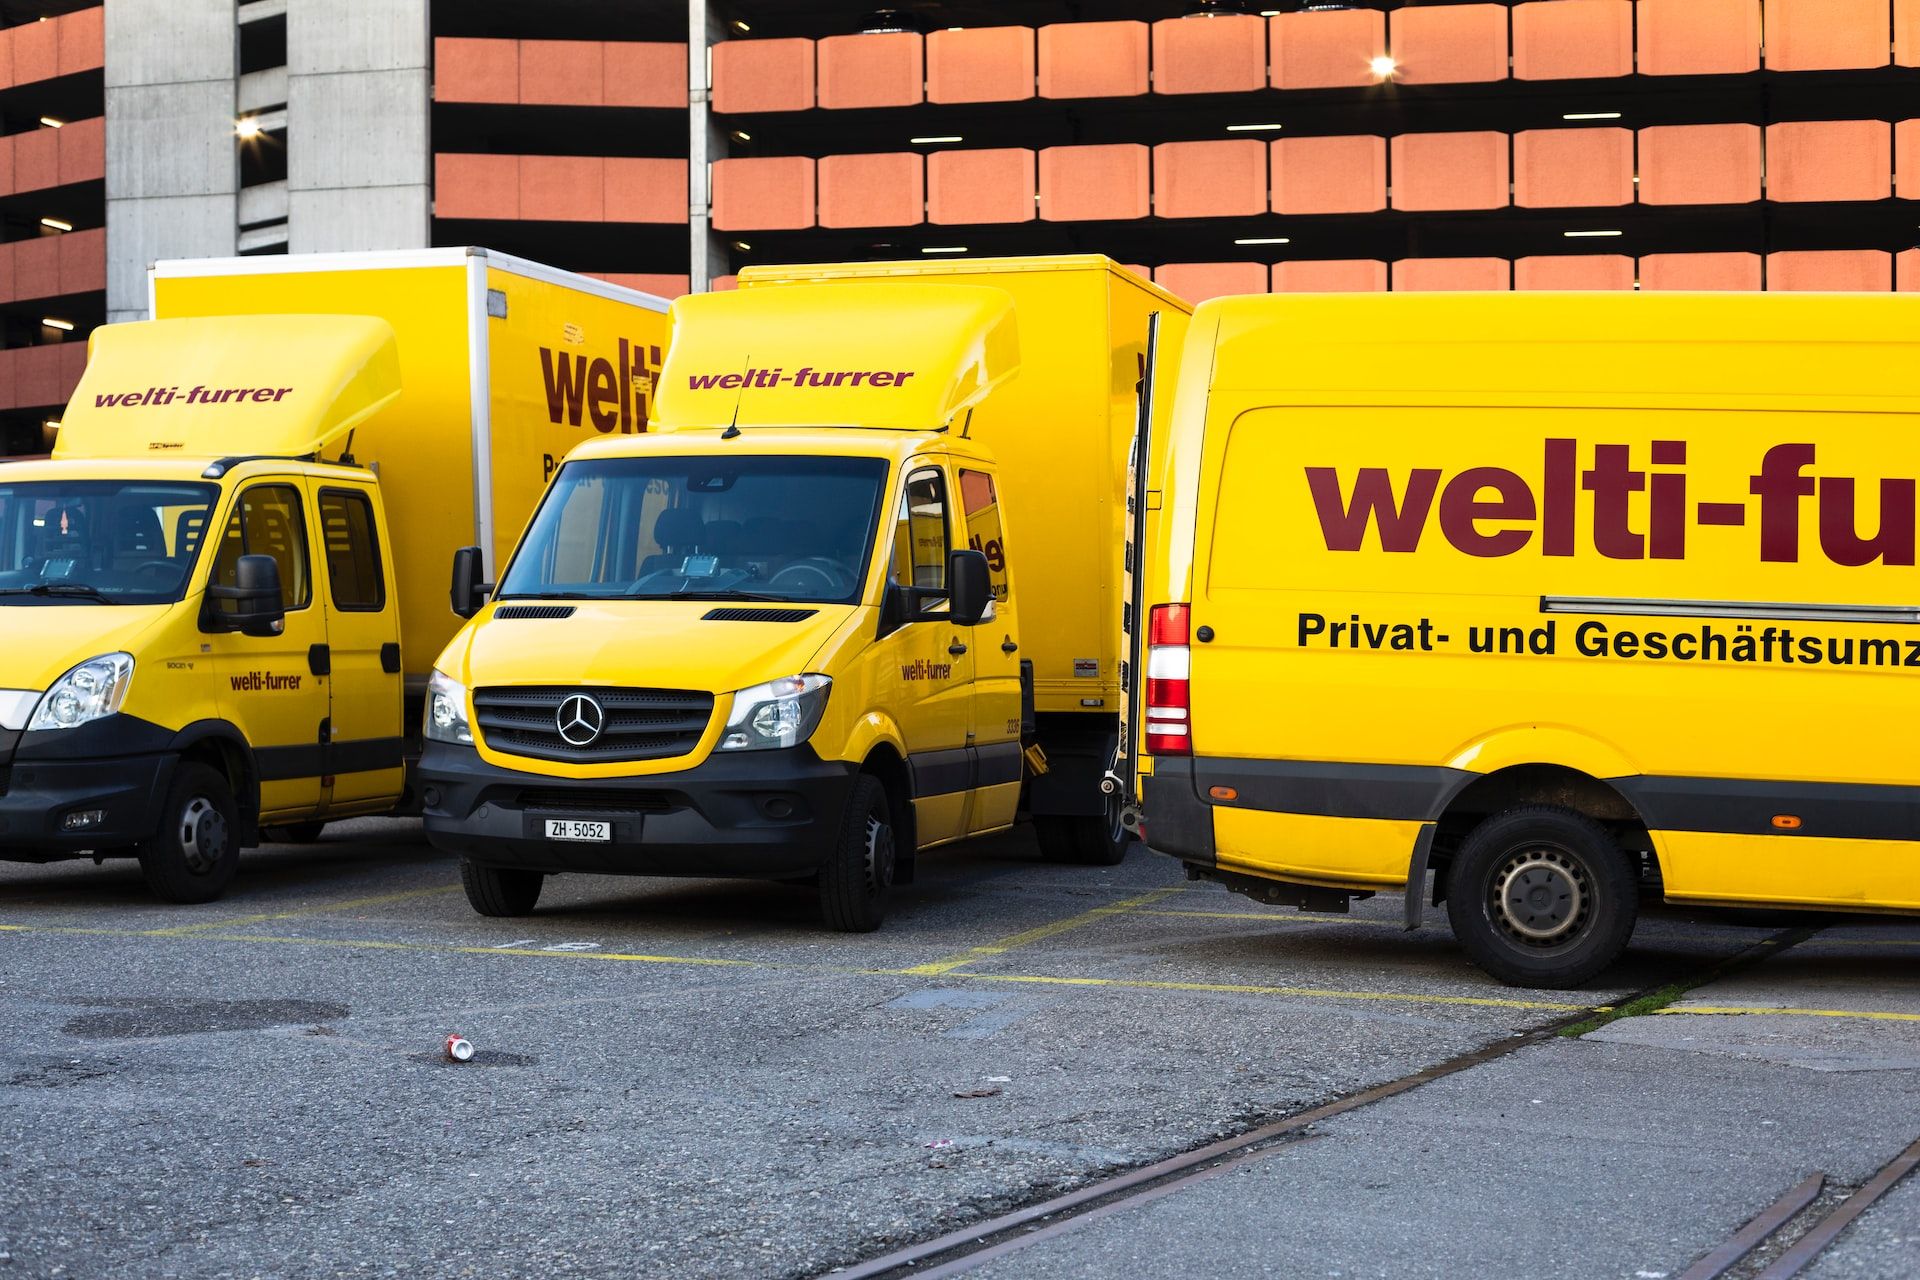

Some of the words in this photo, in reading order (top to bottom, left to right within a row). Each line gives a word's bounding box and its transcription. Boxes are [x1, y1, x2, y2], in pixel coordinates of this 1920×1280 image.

[689, 367, 915, 390] welti-furrer
[95, 385, 293, 408] welti-furrer
[1304, 438, 1917, 567] welti-fu
[1298, 613, 1450, 651] Privat-
[1469, 620, 1556, 655] und
[1575, 621, 1920, 667] Geschäftsumz
[230, 671, 301, 691] welti-furrer
[902, 659, 951, 680] welti-furrer
